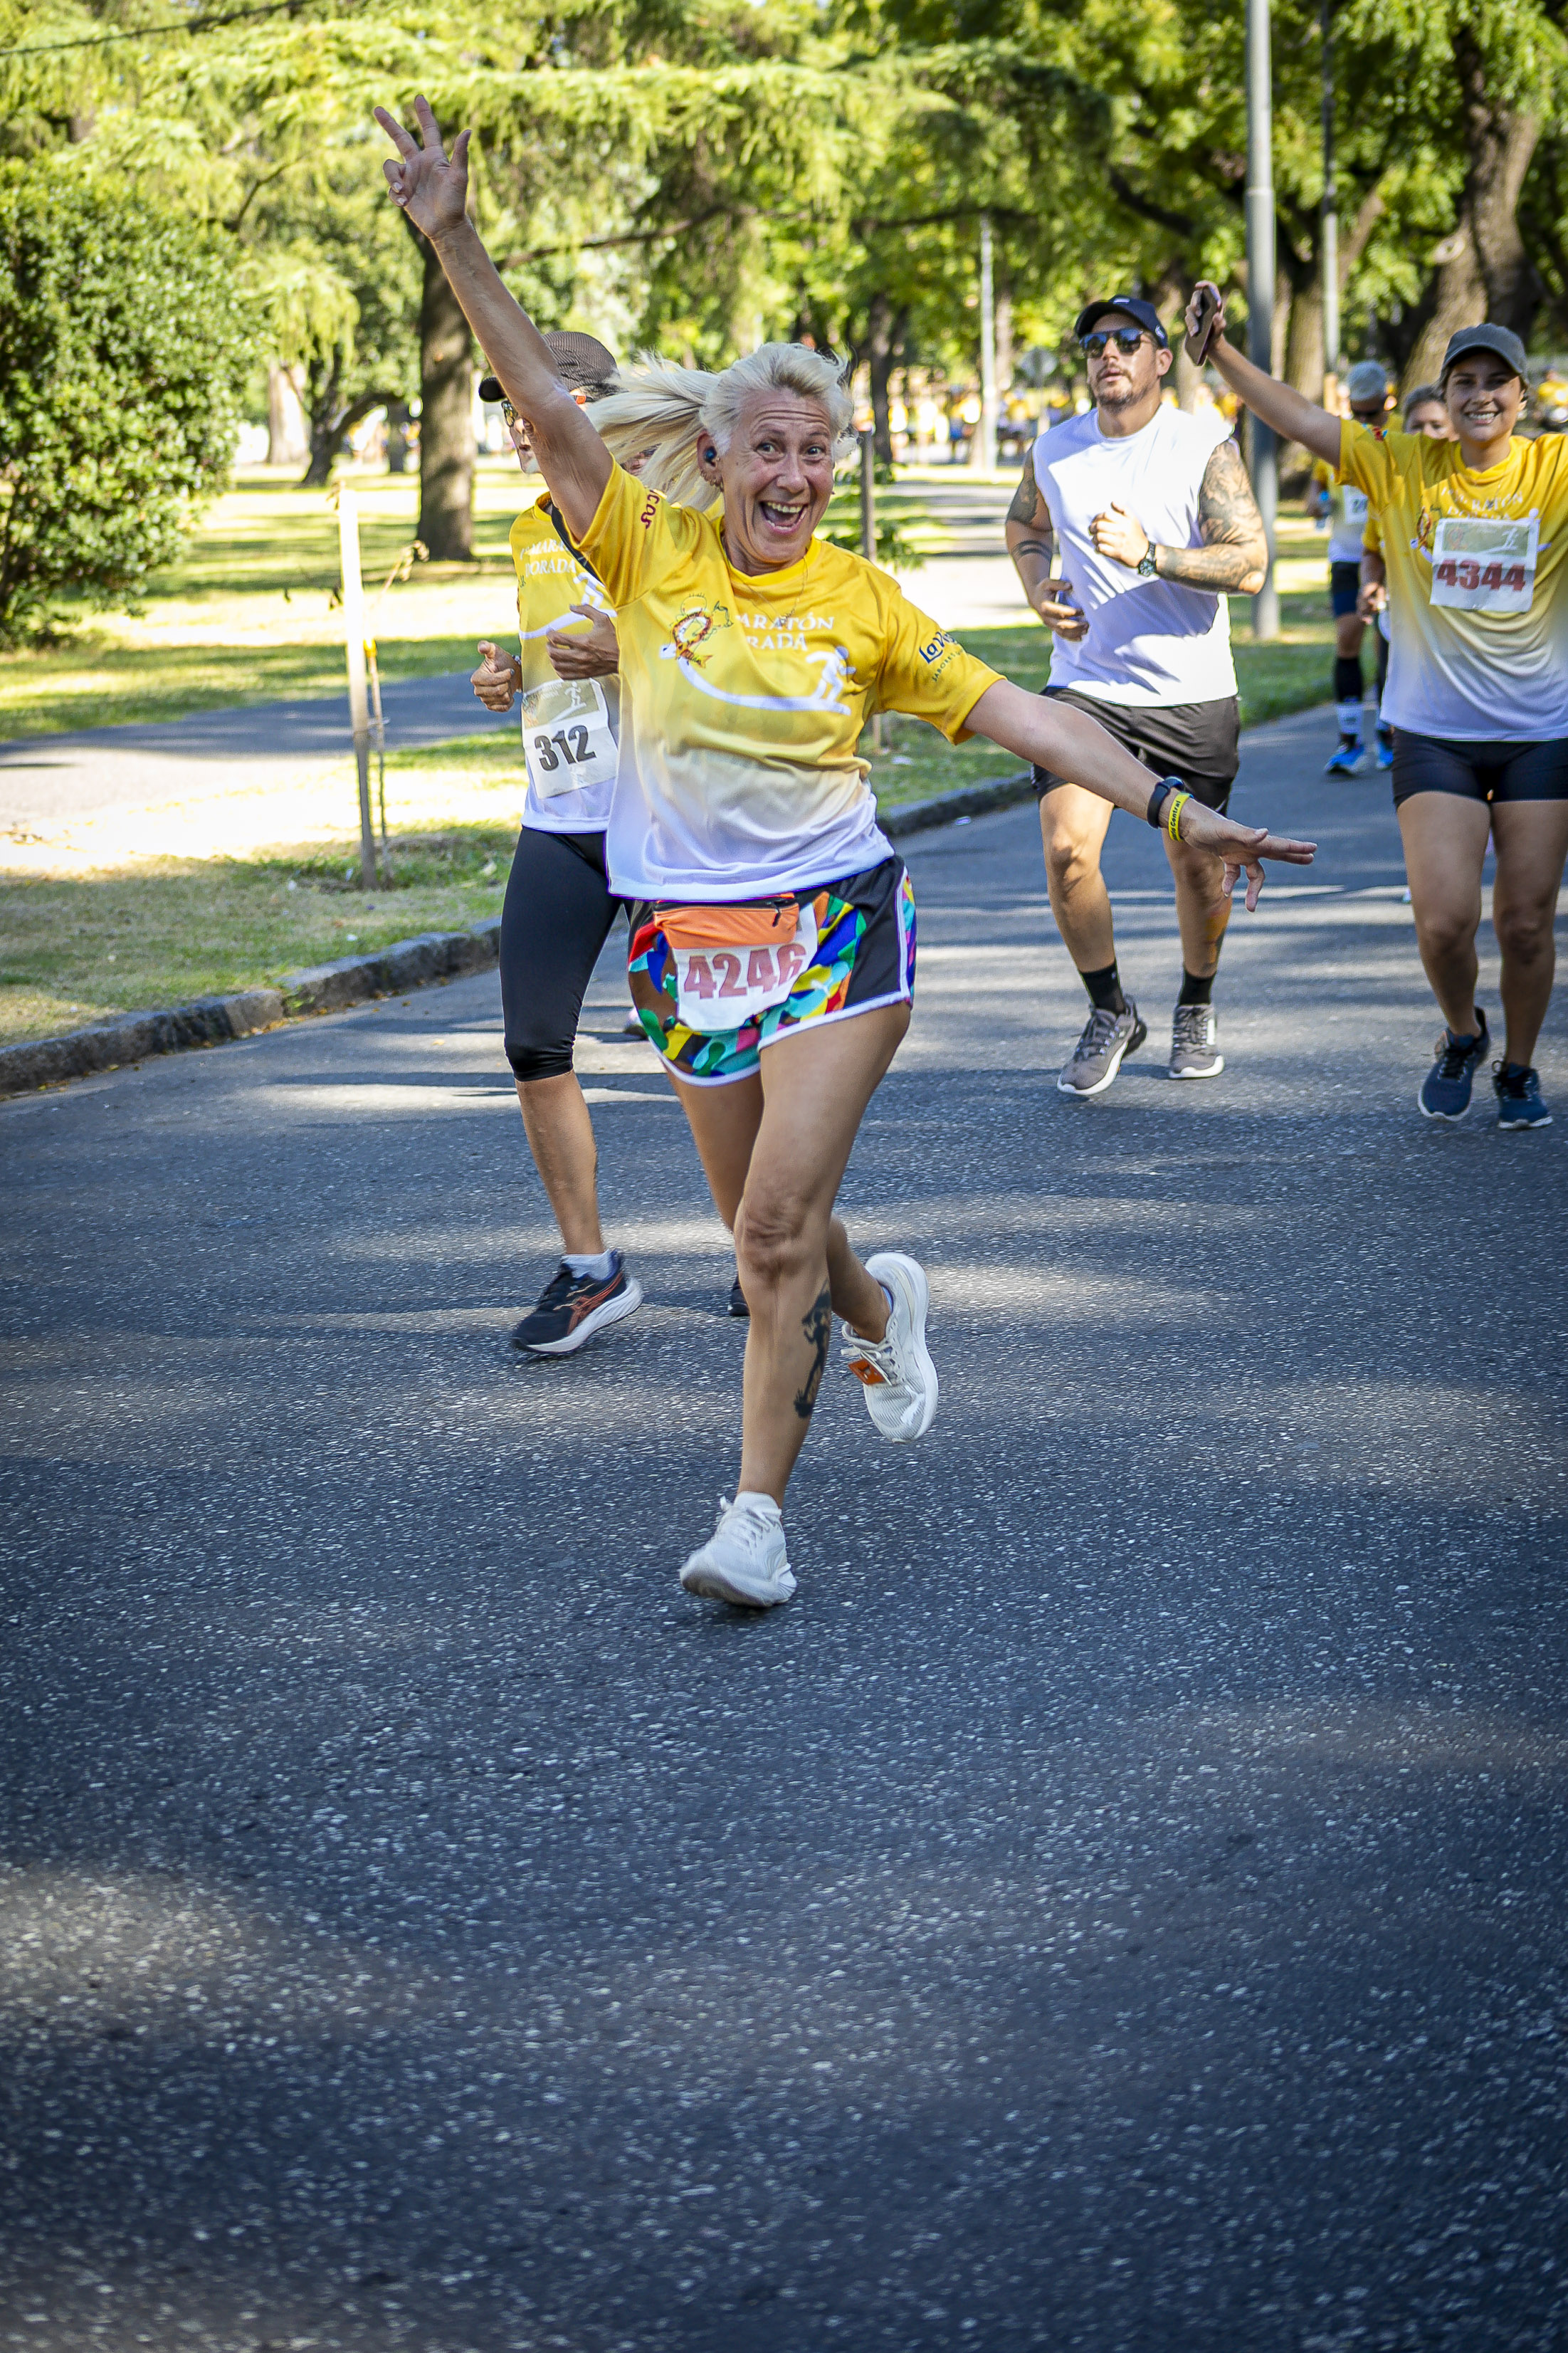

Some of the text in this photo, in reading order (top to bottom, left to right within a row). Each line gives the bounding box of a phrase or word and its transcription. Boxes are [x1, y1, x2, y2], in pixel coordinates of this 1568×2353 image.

[525, 558, 577, 577] DORADA
[1437, 558, 1526, 592] 4344
[735, 612, 834, 631] ARATÓN
[534, 724, 597, 772] 312
[1170, 800, 1182, 827] Central
[684, 943, 807, 1000] 4246
